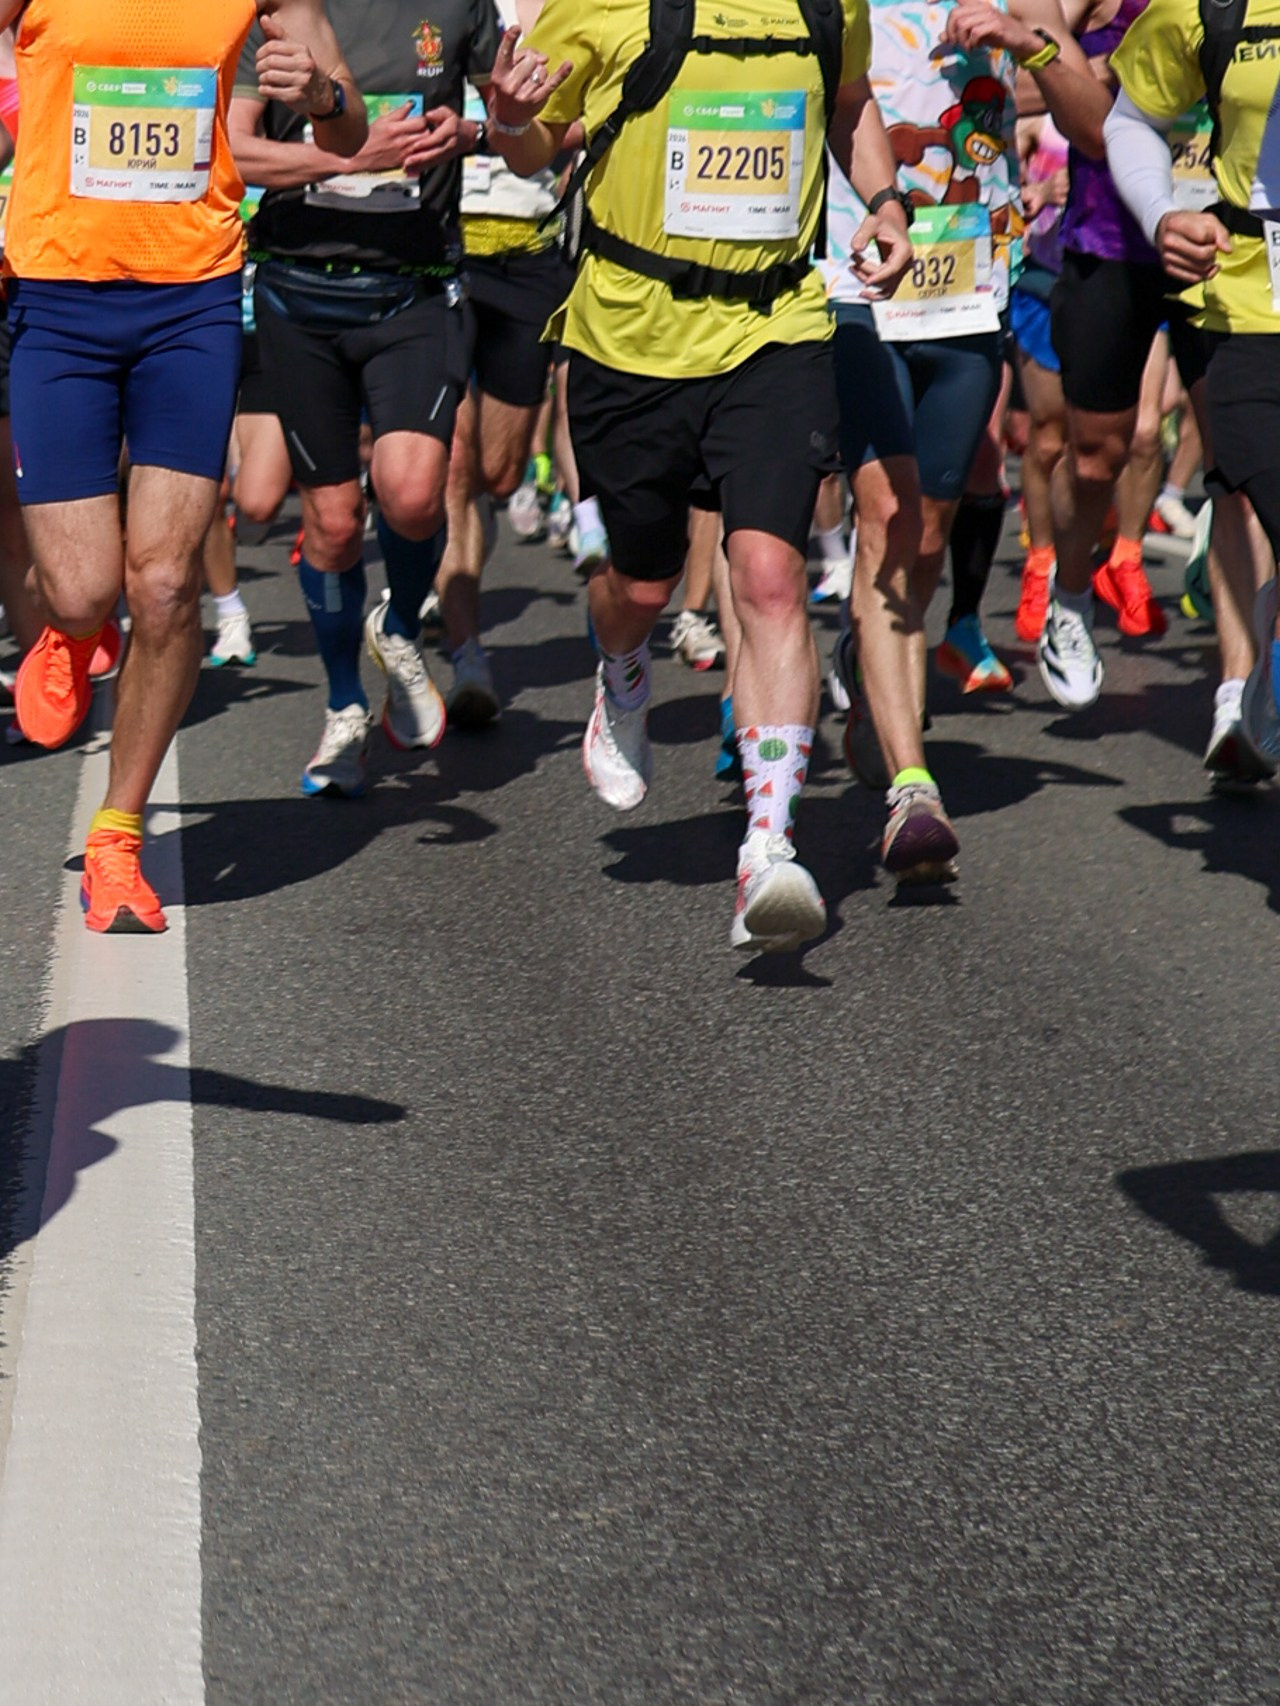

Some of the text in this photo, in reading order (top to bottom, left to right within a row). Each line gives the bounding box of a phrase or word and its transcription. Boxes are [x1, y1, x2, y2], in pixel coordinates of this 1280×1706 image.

[1232, 38, 1280, 64] ЕЙ
[109, 121, 180, 157] 8153
[127, 158, 157, 169] ЮРИЙ
[697, 145, 785, 181] 22205
[96, 179, 133, 189] МАГНИТ
[692, 204, 731, 214] МАГНИТ
[912, 255, 956, 288] 832
